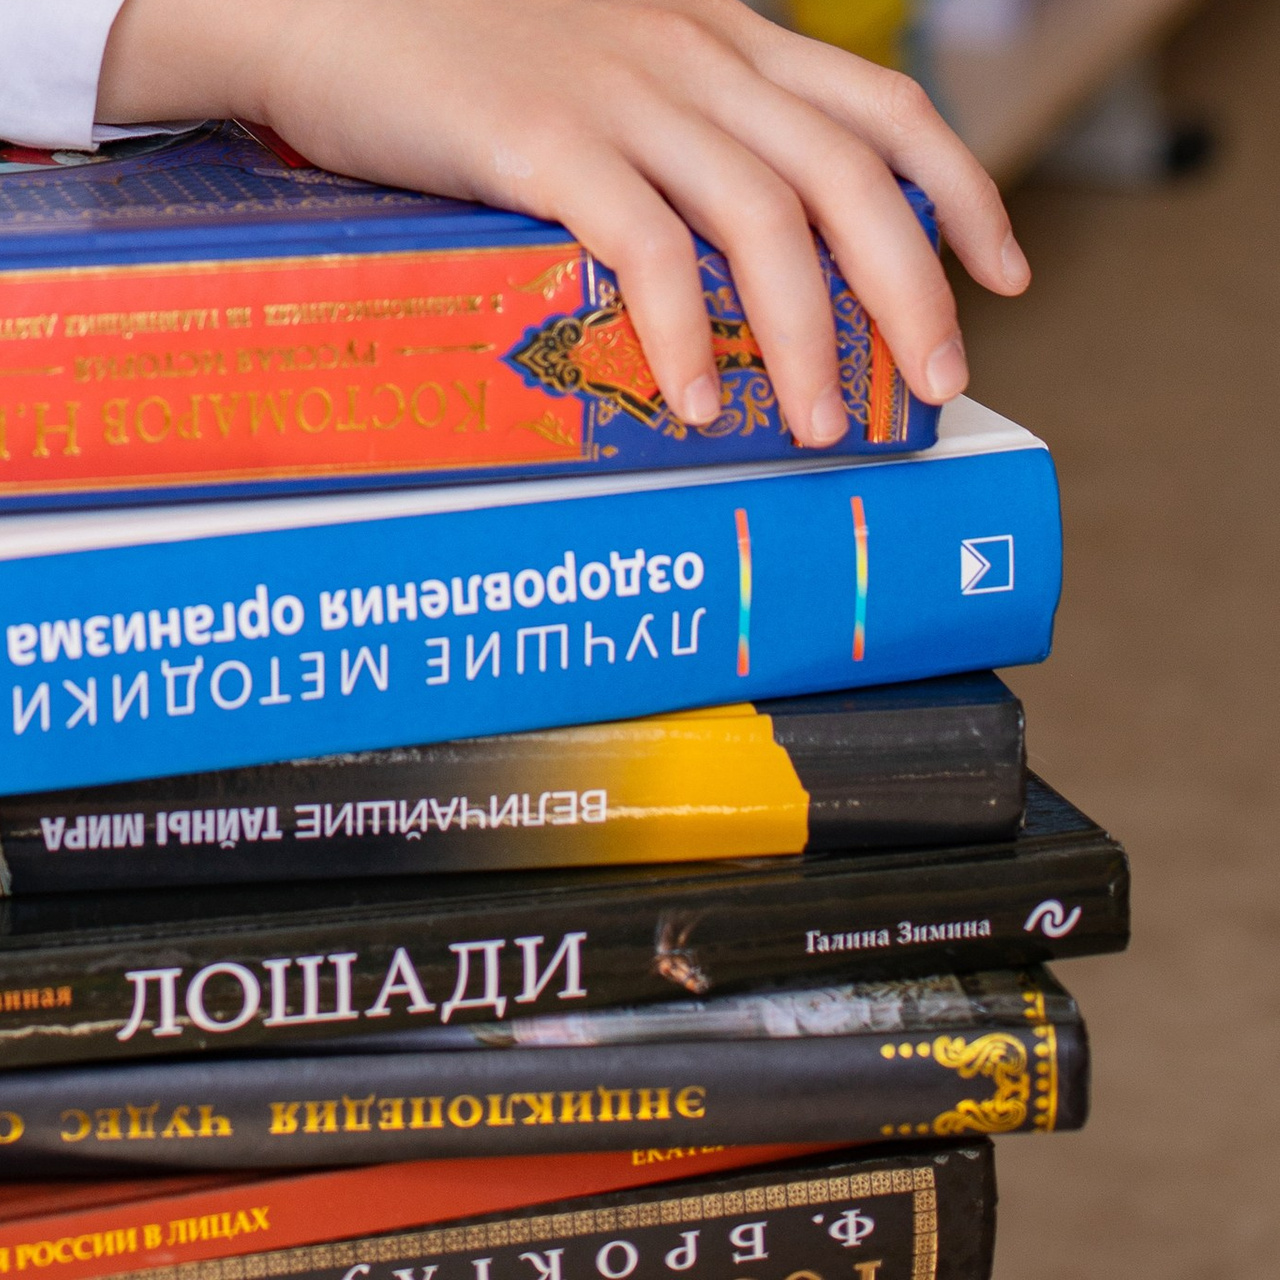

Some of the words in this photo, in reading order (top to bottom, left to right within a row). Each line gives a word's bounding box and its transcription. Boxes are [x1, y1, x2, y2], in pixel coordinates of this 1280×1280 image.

[73, 348, 227, 383] ИСТОРИЯ
[236, 339, 379, 374] РУССКАЯ
[101, 379, 489, 445] КОСТОМАРОВ
[319, 548, 705, 630] оздоровления
[5, 584, 305, 667] организма
[425, 606, 706, 686] ЛУЧШИЕ
[11, 642, 389, 735] МЕТОДИКИ
[41, 813, 144, 852] МИРА
[157, 806, 282, 849] ТАЙНЫ
[295, 790, 608, 840] ВЕЛИЧАЙШИЕ
[805, 929, 888, 953] Галина
[897, 919, 991, 944] Зимина
[116, 931, 587, 1041] ЛОШАДИ
[60, 1101, 233, 1142] ЧУДЕС
[270, 1085, 706, 1135] ЭНЦИКЛОПЕДИЯ
[16, 1229, 137, 1270] РОССИИ
[144, 1224, 161, 1247] В
[167, 1206, 271, 1247] ЛИЦАХ
[812, 1208, 875, 1247] Ф.
